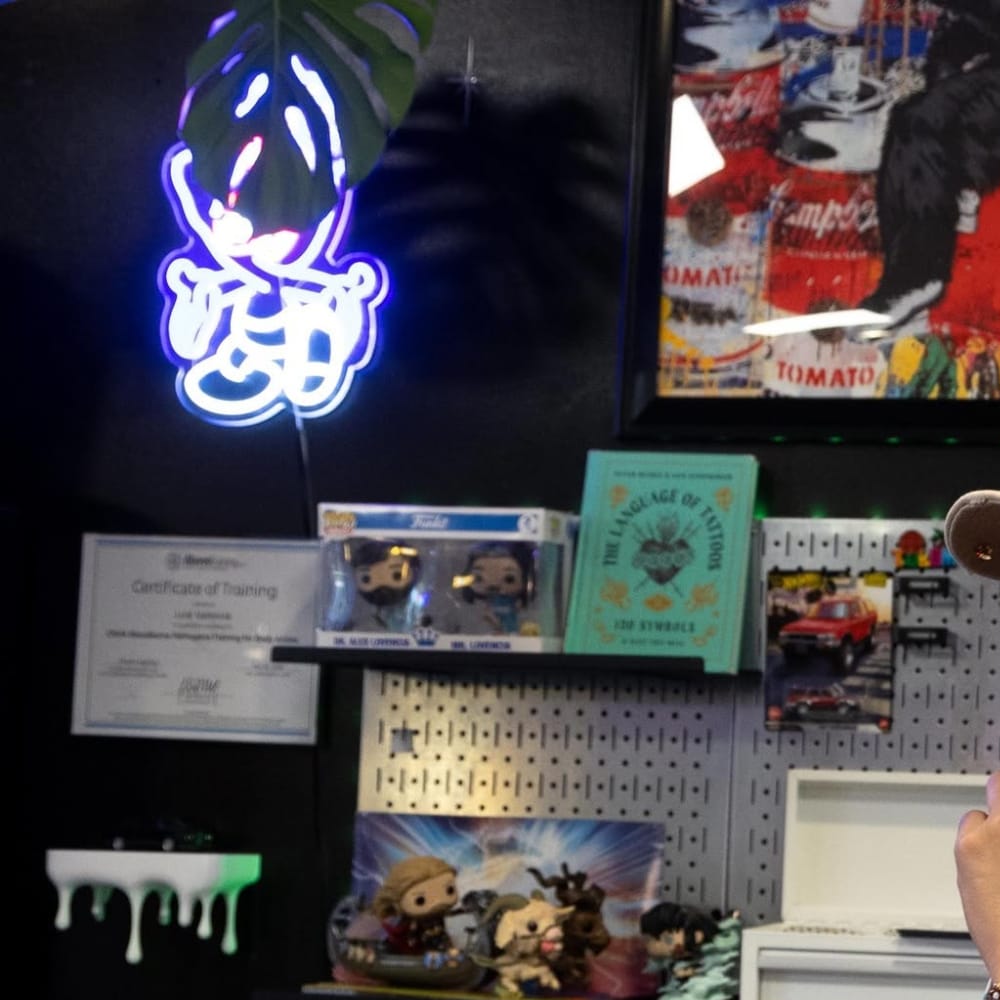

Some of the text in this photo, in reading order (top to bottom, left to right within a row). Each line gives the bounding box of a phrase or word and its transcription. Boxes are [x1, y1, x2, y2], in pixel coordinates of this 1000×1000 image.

[660, 263, 743, 288] OMAT
[776, 361, 876, 389] TOMATO
[602, 487, 726, 573] THE LANGUAGE OF TATTOOS
[131, 578, 279, 601] Certificate of Training
